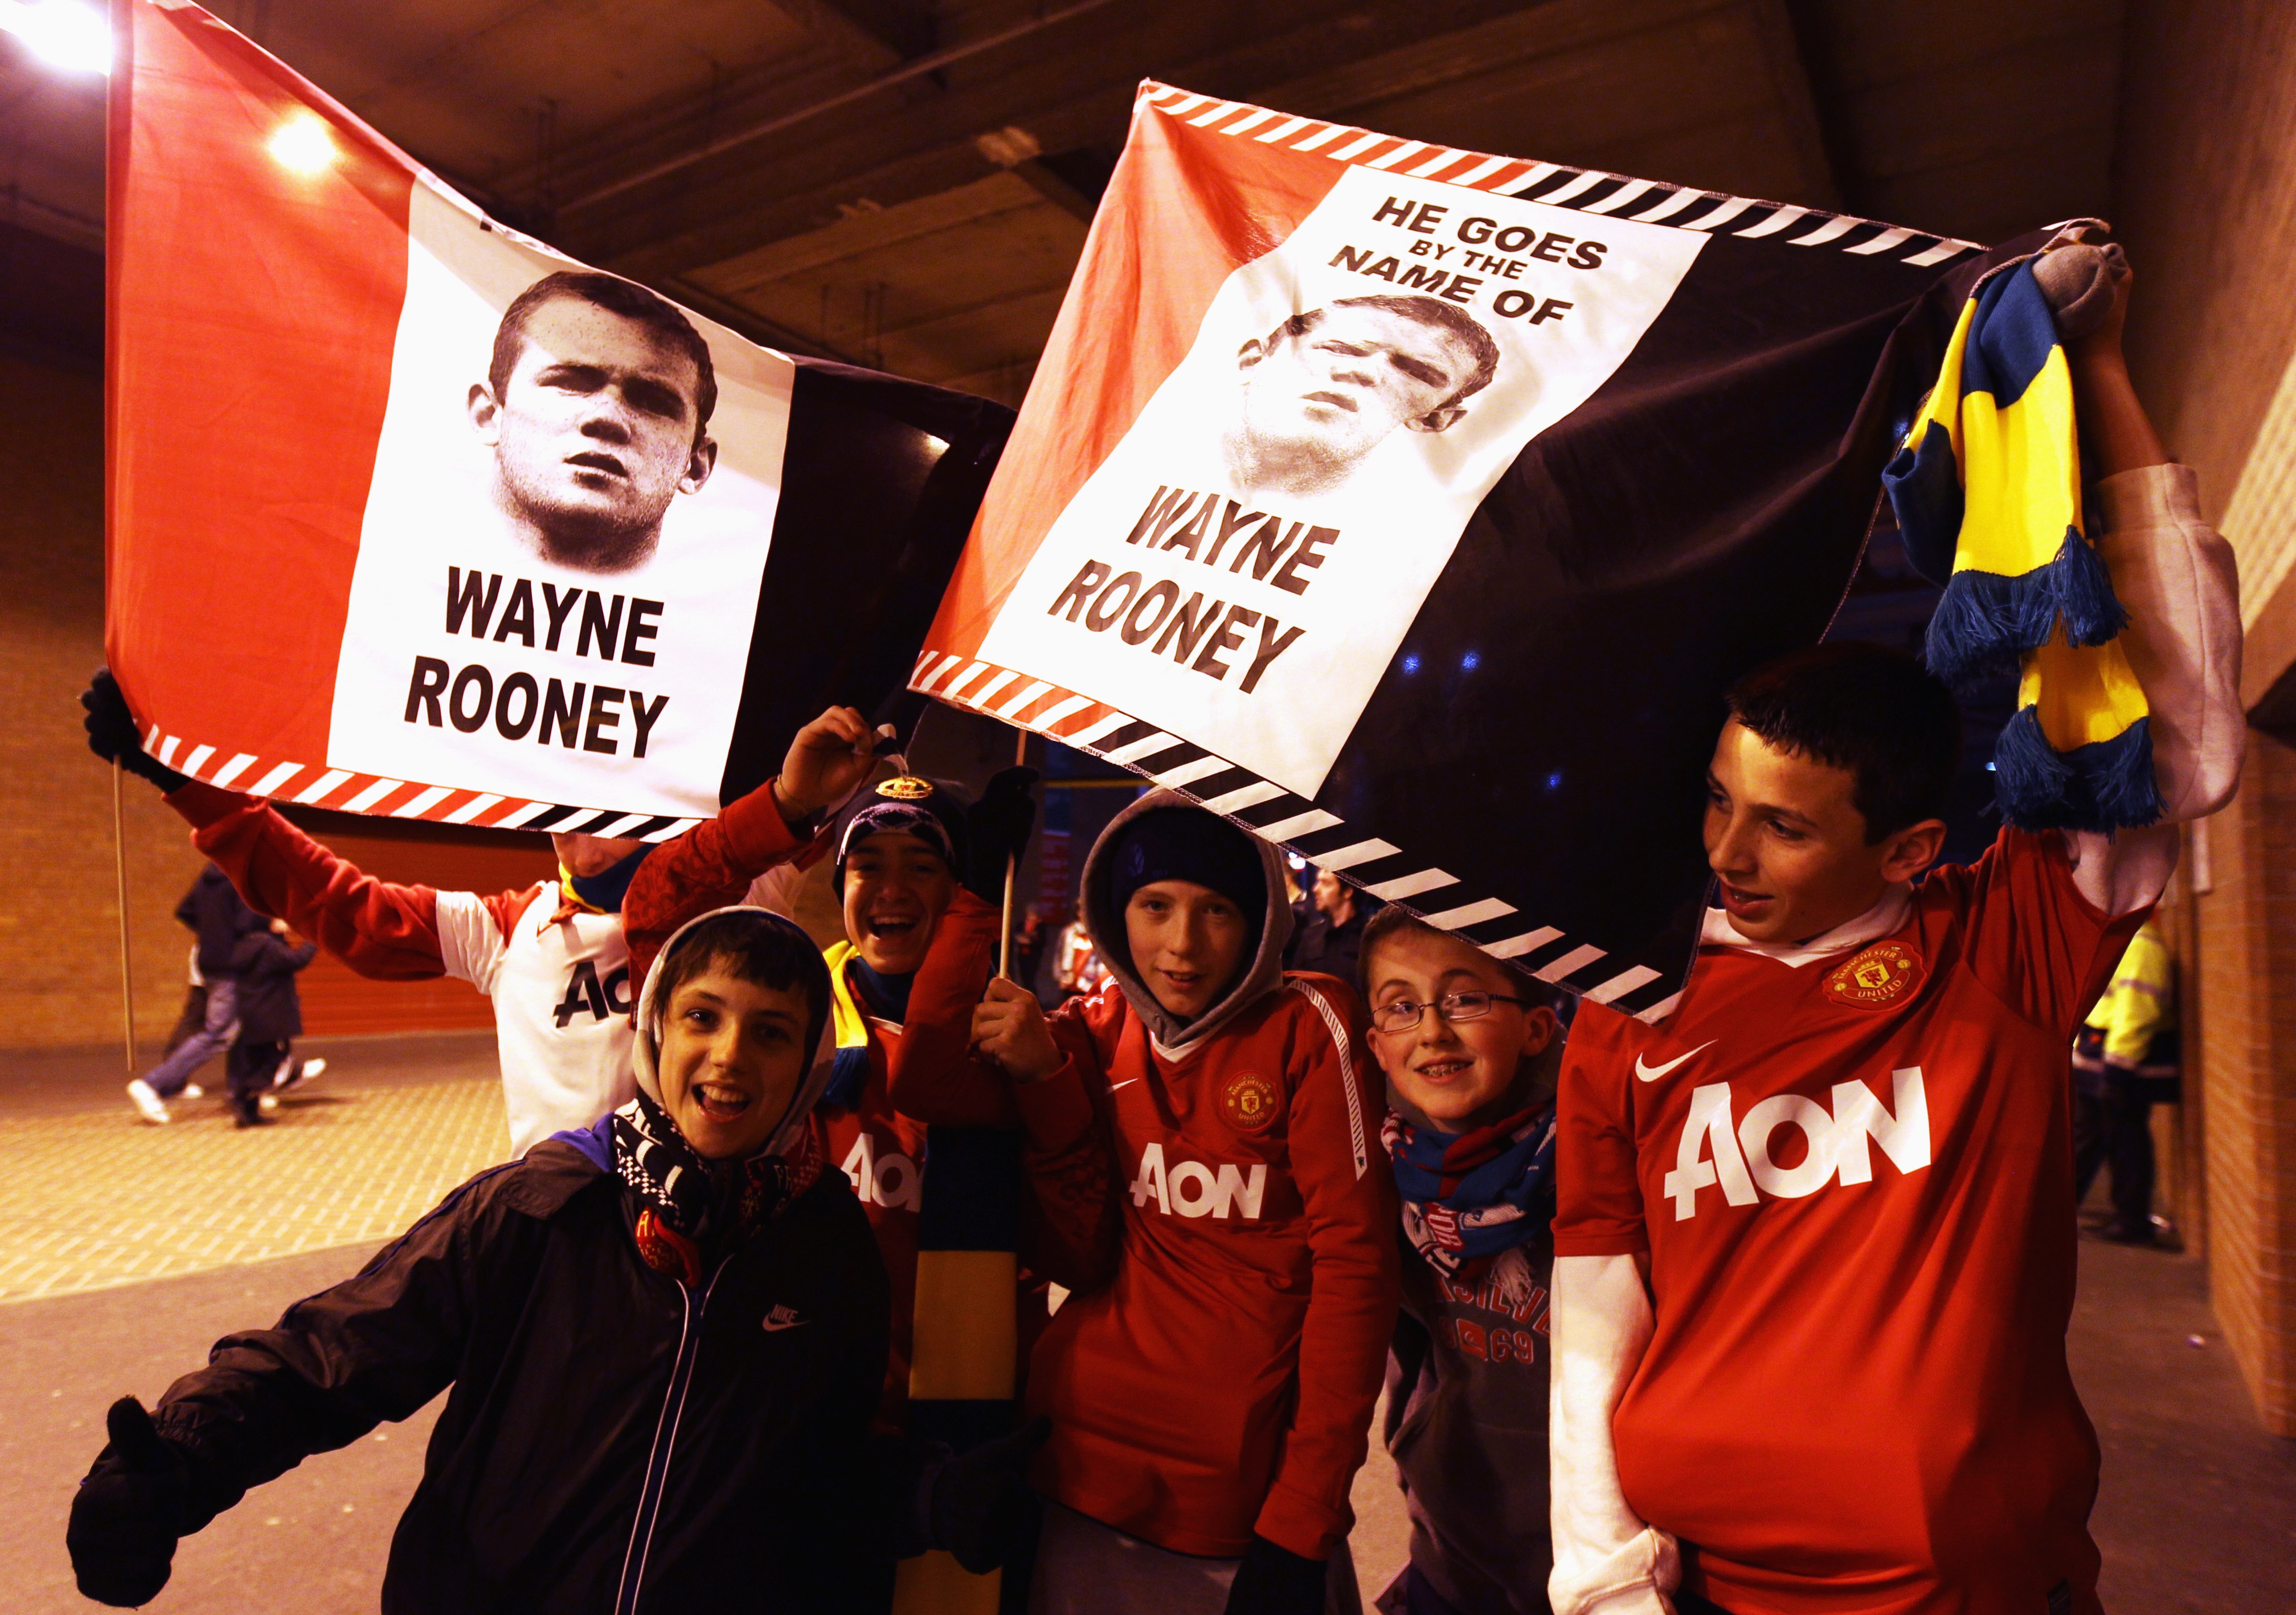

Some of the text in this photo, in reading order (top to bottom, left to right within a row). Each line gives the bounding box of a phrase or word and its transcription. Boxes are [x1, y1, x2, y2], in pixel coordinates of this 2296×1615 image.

[1372, 196, 1608, 270] HE GOES
[1408, 239, 1528, 279] BY THE
[1328, 245, 1574, 327] NAME OF
[1125, 485, 1341, 596] WAYNE
[445, 565, 665, 667] WAYNE
[1047, 559, 1307, 695] ROONEY
[404, 655, 670, 759] ROONEY
[553, 961, 631, 1029] AO
[1857, 979, 1902, 998] UNITED
[840, 1132, 921, 1213] AO
[769, 1303, 799, 1324] NIKE
